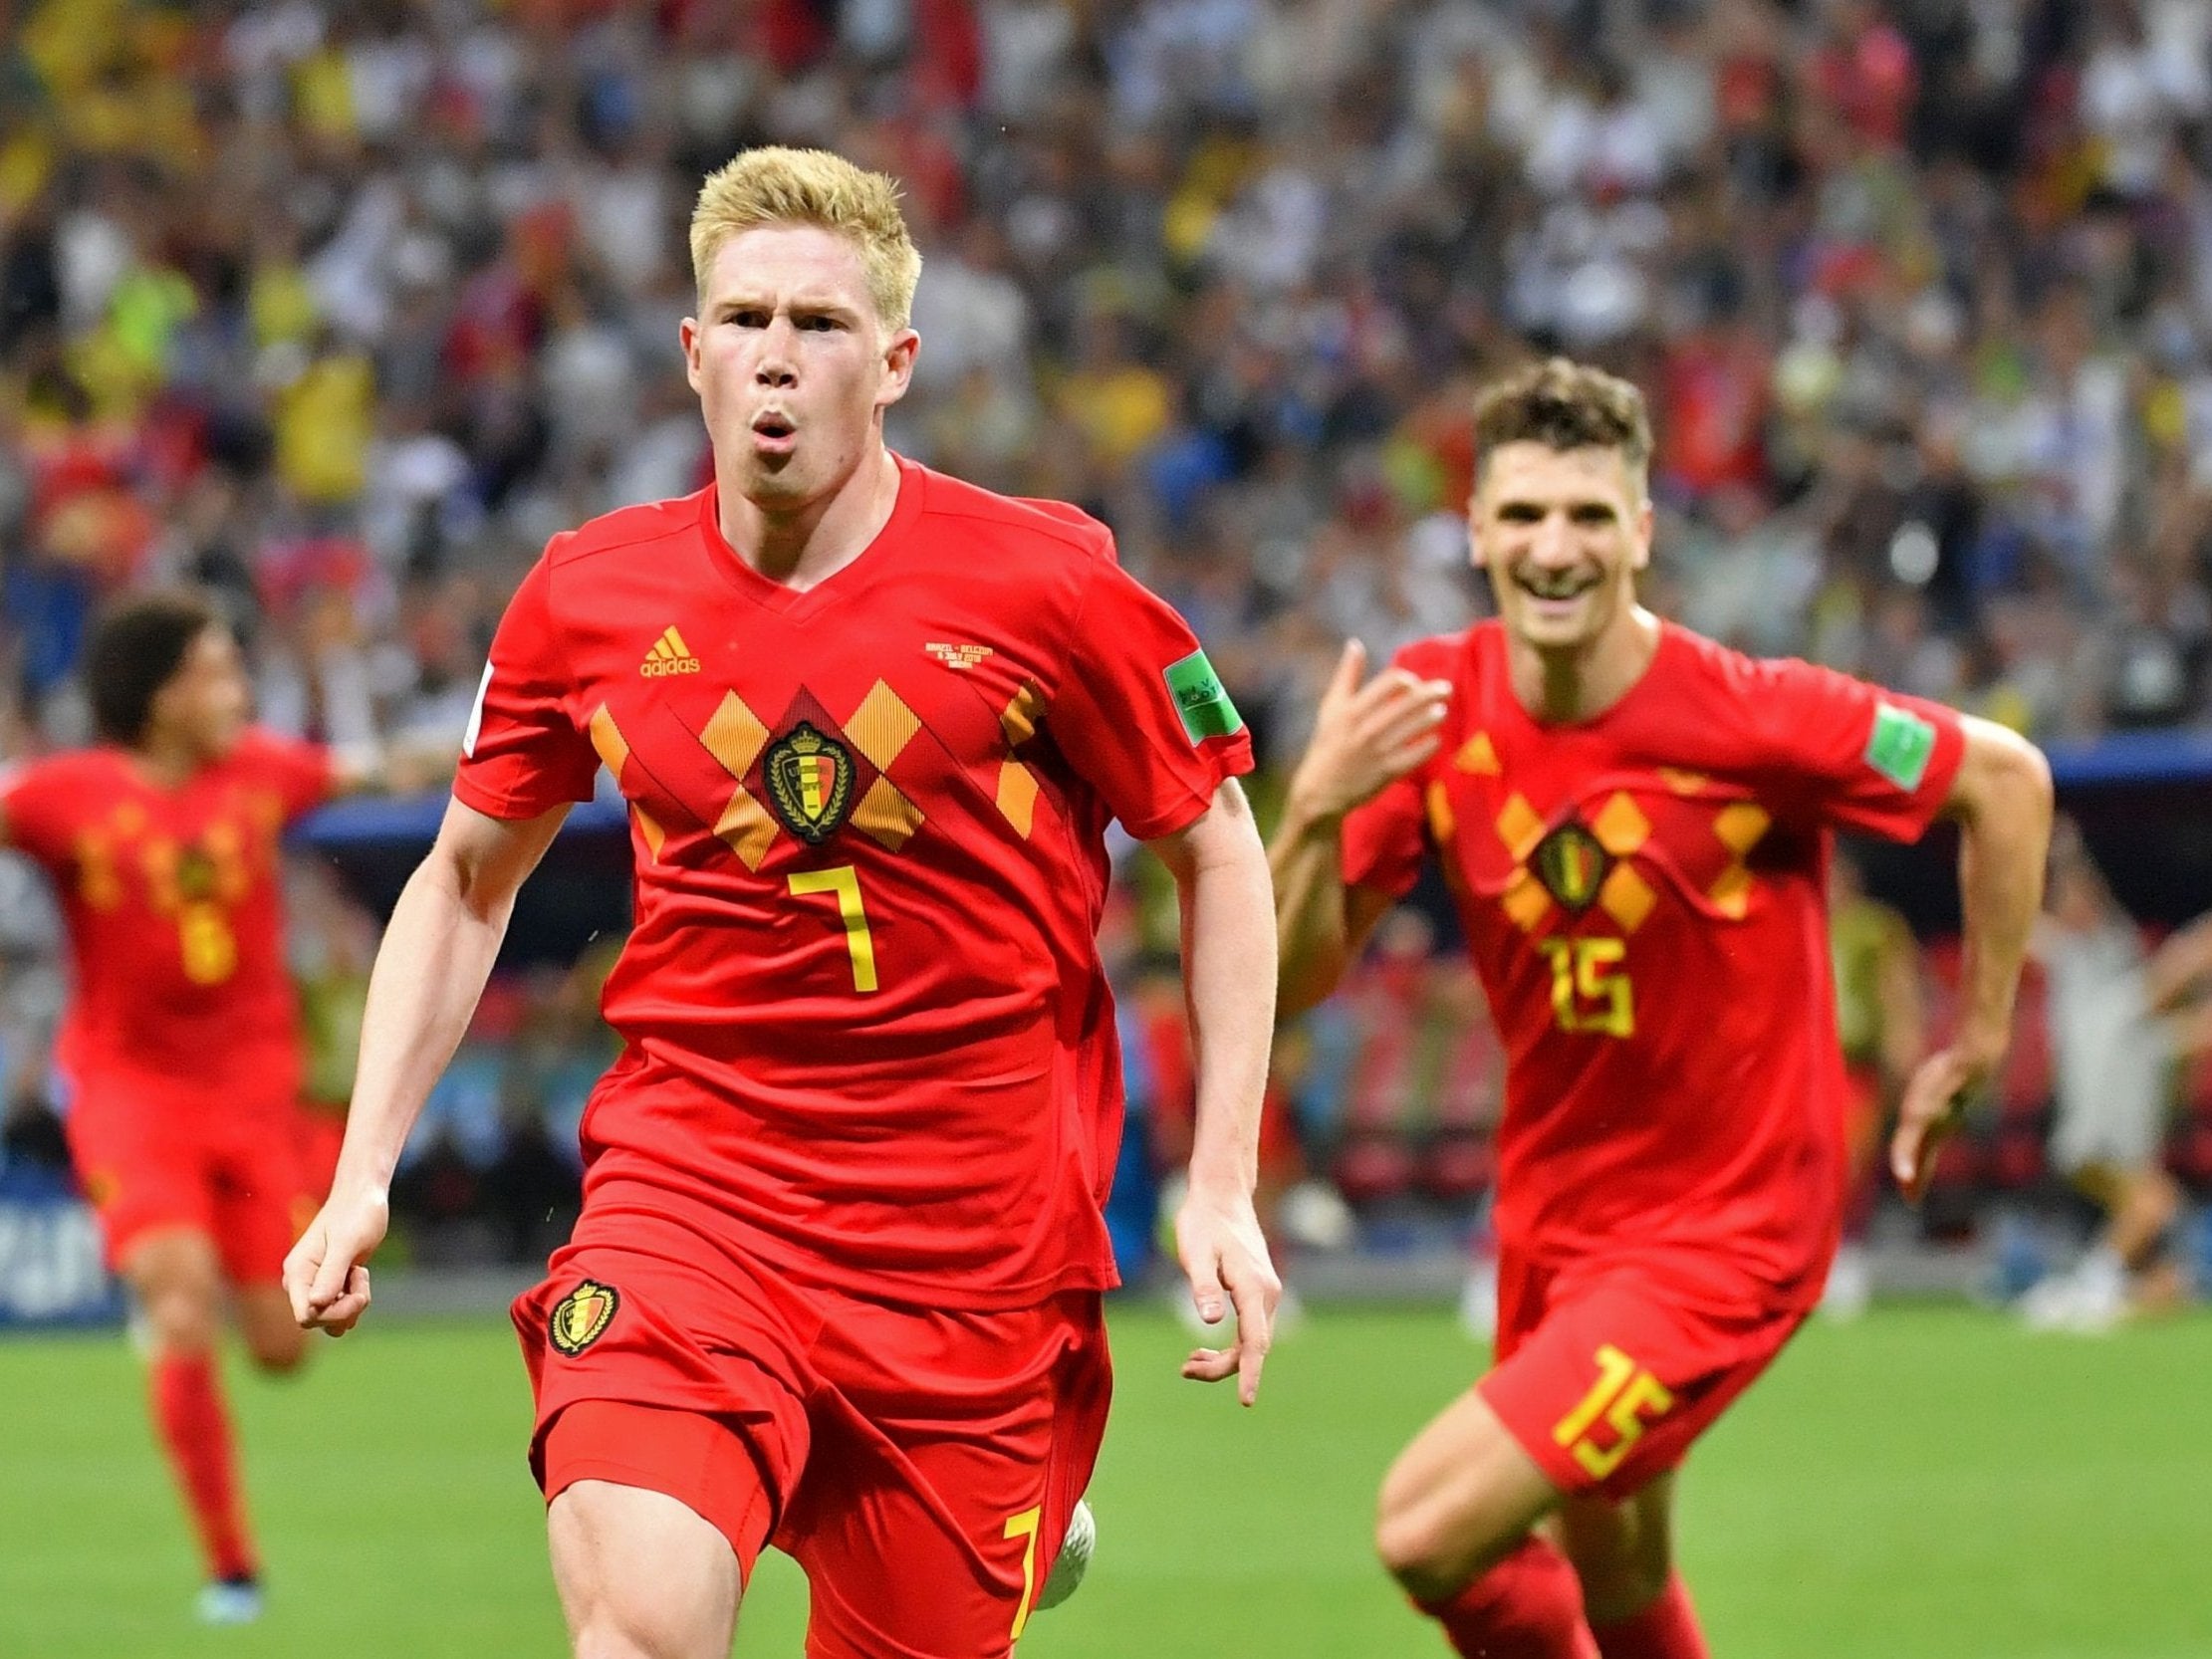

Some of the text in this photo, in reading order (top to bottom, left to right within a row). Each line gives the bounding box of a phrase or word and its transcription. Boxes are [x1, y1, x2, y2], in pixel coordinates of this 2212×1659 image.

[639, 657, 701, 677] adidas
[787, 864, 878, 992] 7
[1539, 938, 1634, 1038] 15
[1552, 1344, 1672, 1480] 15
[1003, 1504, 1041, 1640] 7
